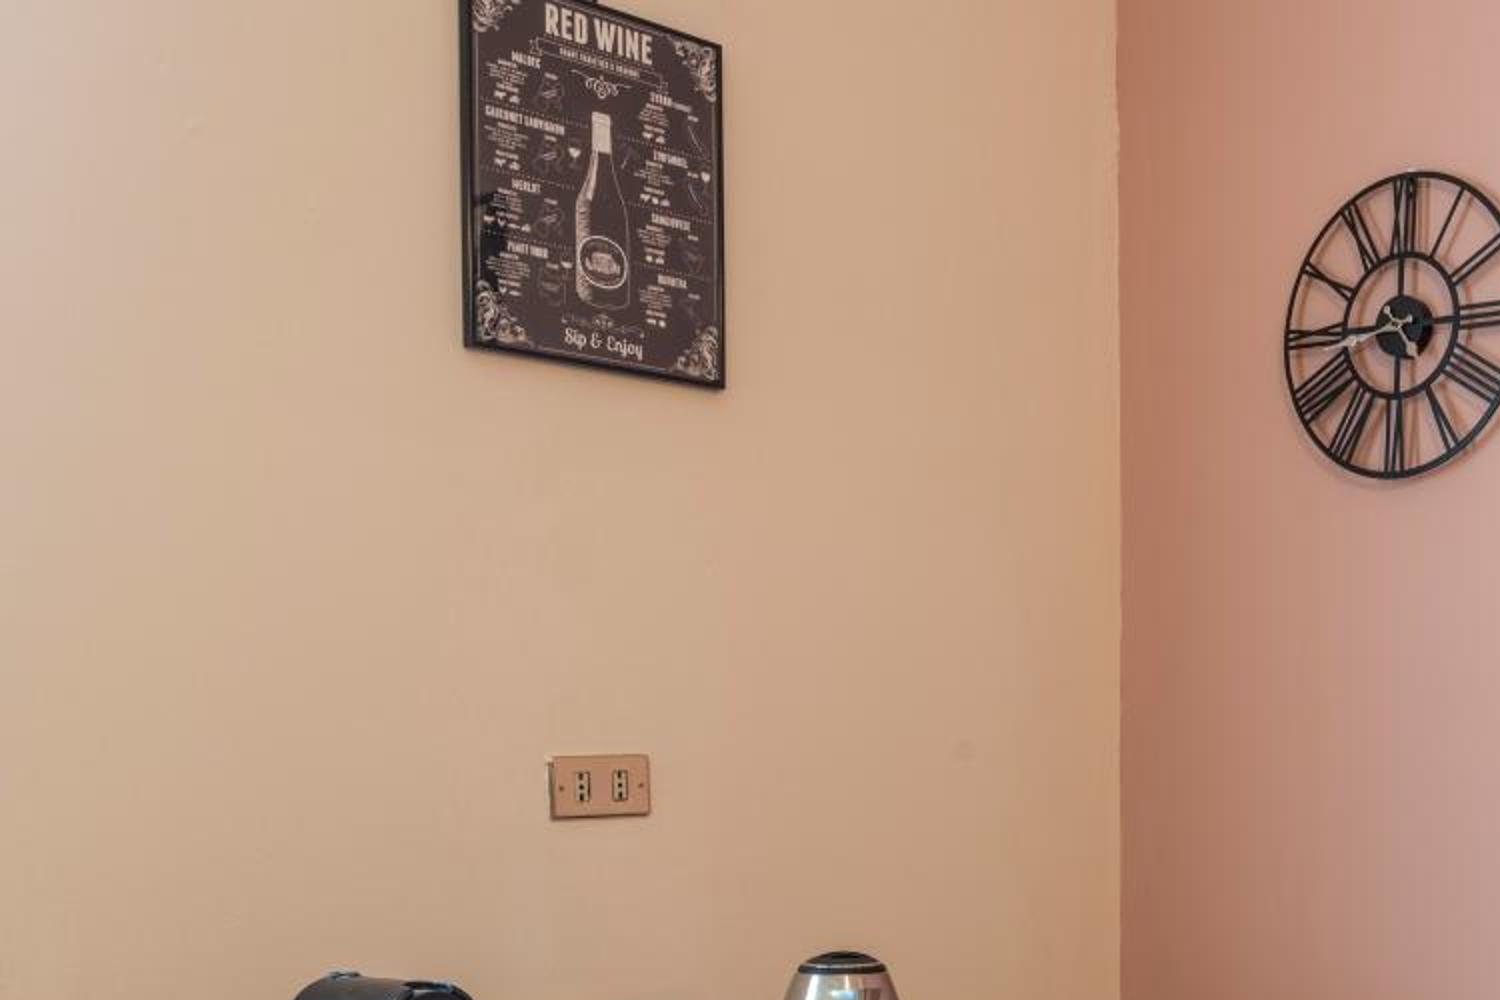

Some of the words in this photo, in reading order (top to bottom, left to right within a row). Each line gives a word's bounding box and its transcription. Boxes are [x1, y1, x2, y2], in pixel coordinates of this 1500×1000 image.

[544, 3, 588, 45] RED
[593, 19, 653, 65] WINE
[564, 328, 586, 349] Sip
[591, 334, 602, 348] &
[606, 339, 643, 360] Enjoy
